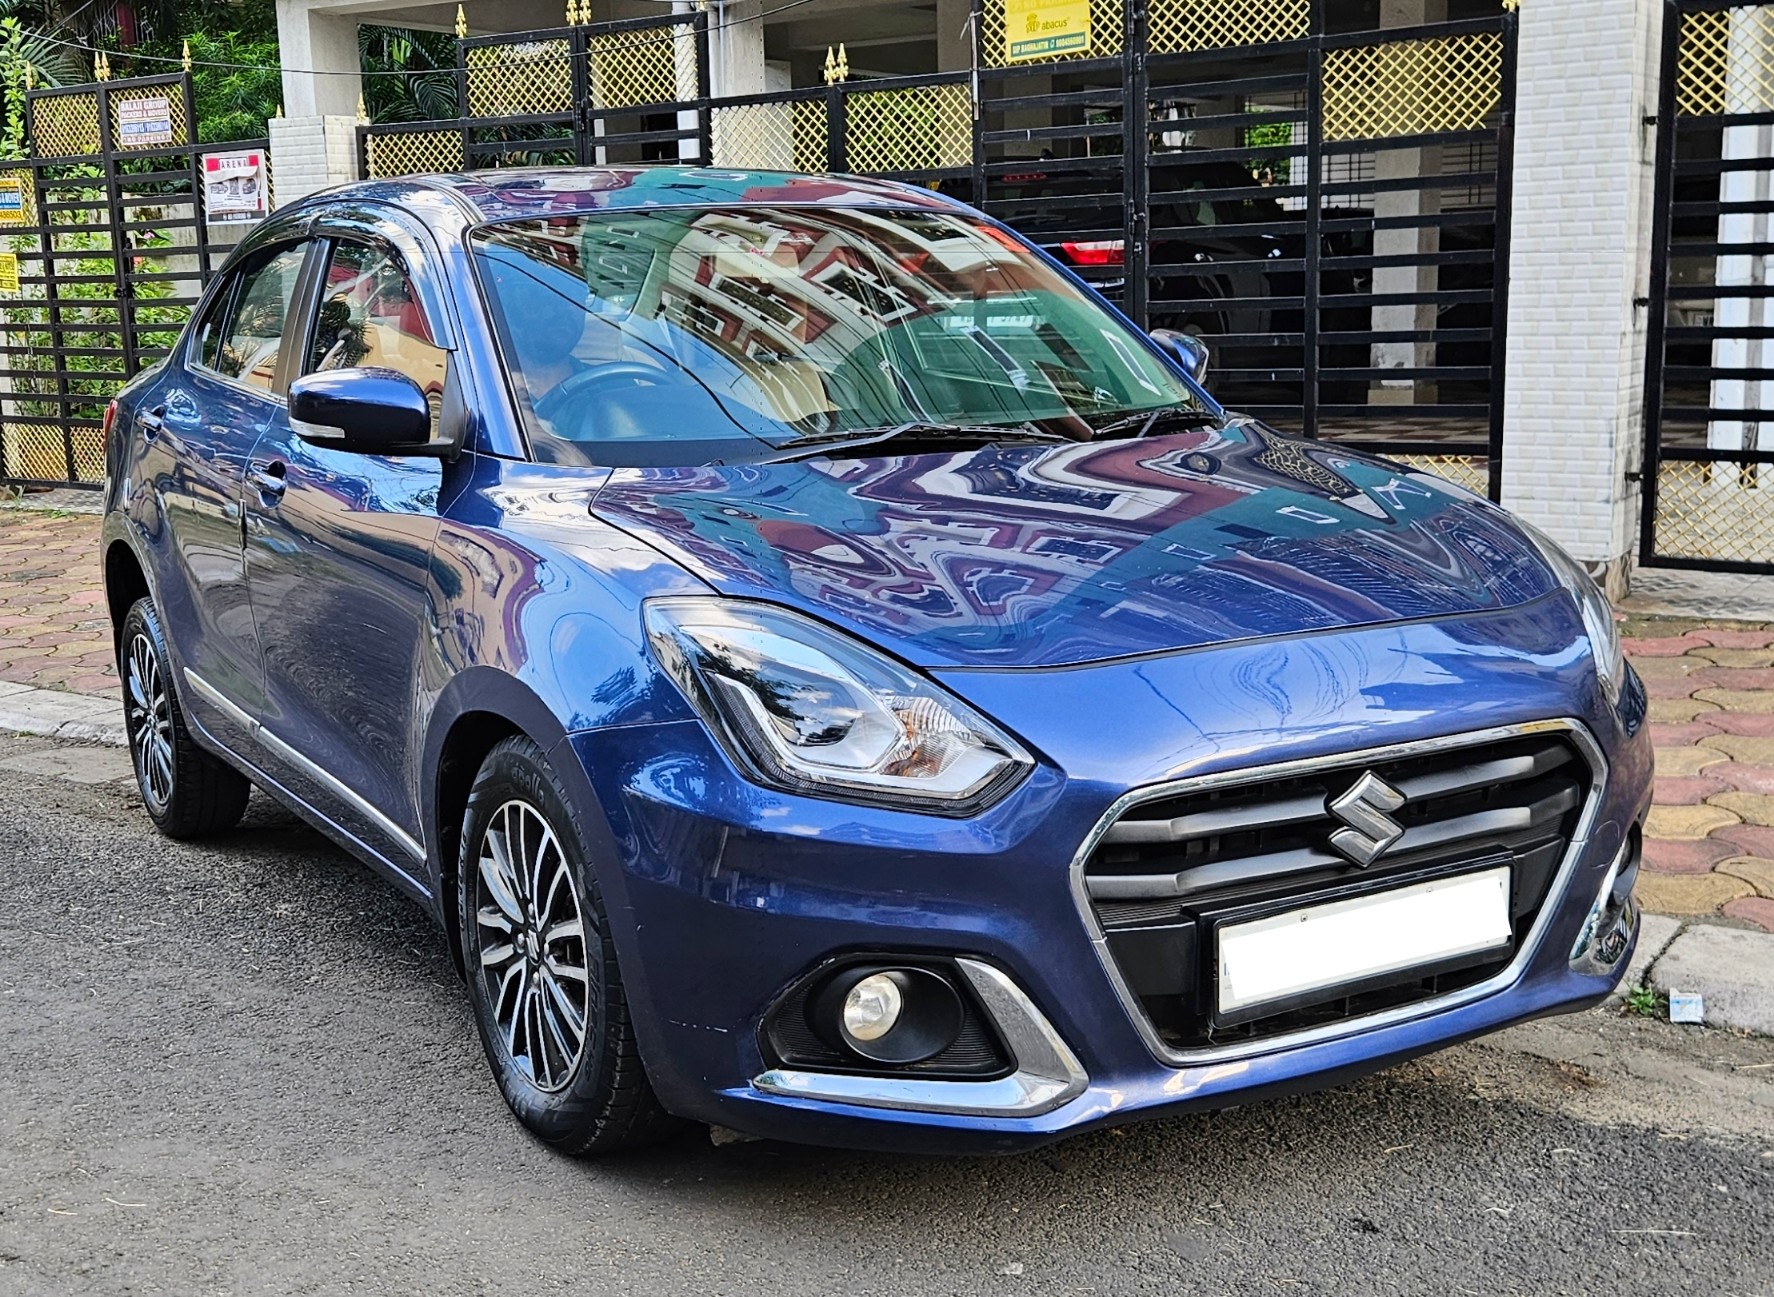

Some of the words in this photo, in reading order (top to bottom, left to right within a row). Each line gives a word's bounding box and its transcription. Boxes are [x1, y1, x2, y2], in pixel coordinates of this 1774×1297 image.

[1041, 19, 1068, 31] abacus
[121, 101, 142, 111] BALAJI
[144, 100, 166, 110] GROUP
